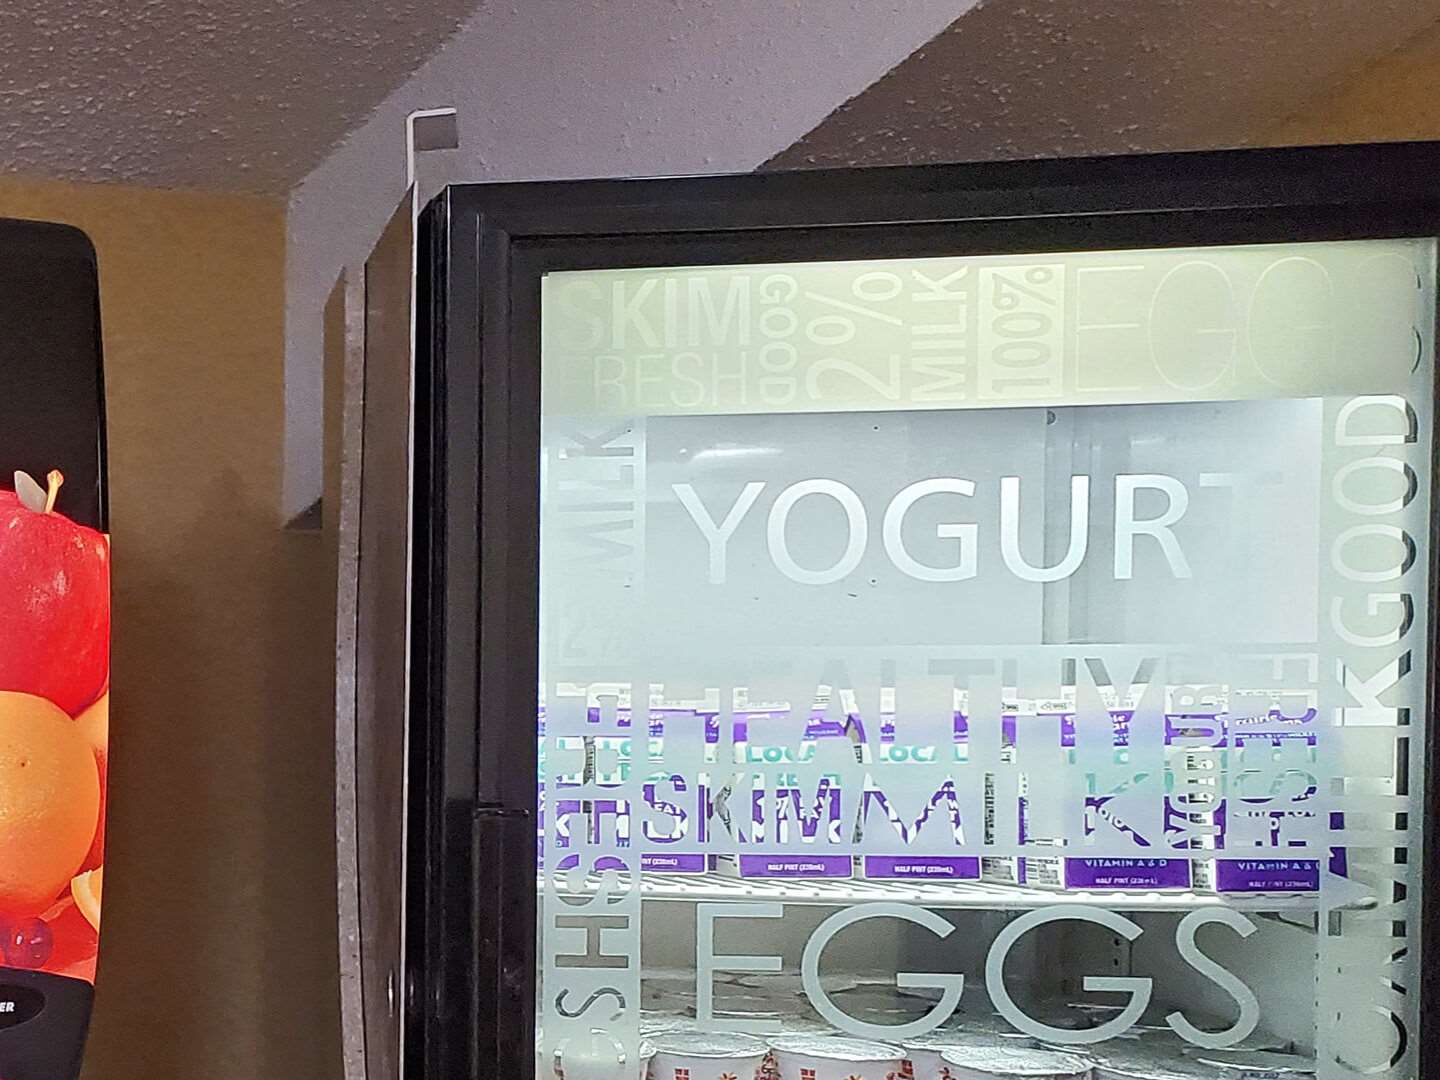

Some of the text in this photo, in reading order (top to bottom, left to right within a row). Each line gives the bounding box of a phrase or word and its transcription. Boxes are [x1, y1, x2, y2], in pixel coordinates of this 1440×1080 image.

[560, 275, 752, 350] SKIM
[760, 274, 798, 405] GOOD
[805, 270, 903, 402] 2%
[911, 265, 968, 402] MILK
[990, 267, 1056, 396] 100%
[1331, 395, 1419, 648] GOOD
[648, 656, 1161, 765] HEALTHY
[642, 771, 1152, 847] SKIM MILK
[1085, 859, 1133, 867] VITAMIN
[1238, 862, 1288, 870] VITAMIN
[696, 902, 1262, 1050] EGGS
